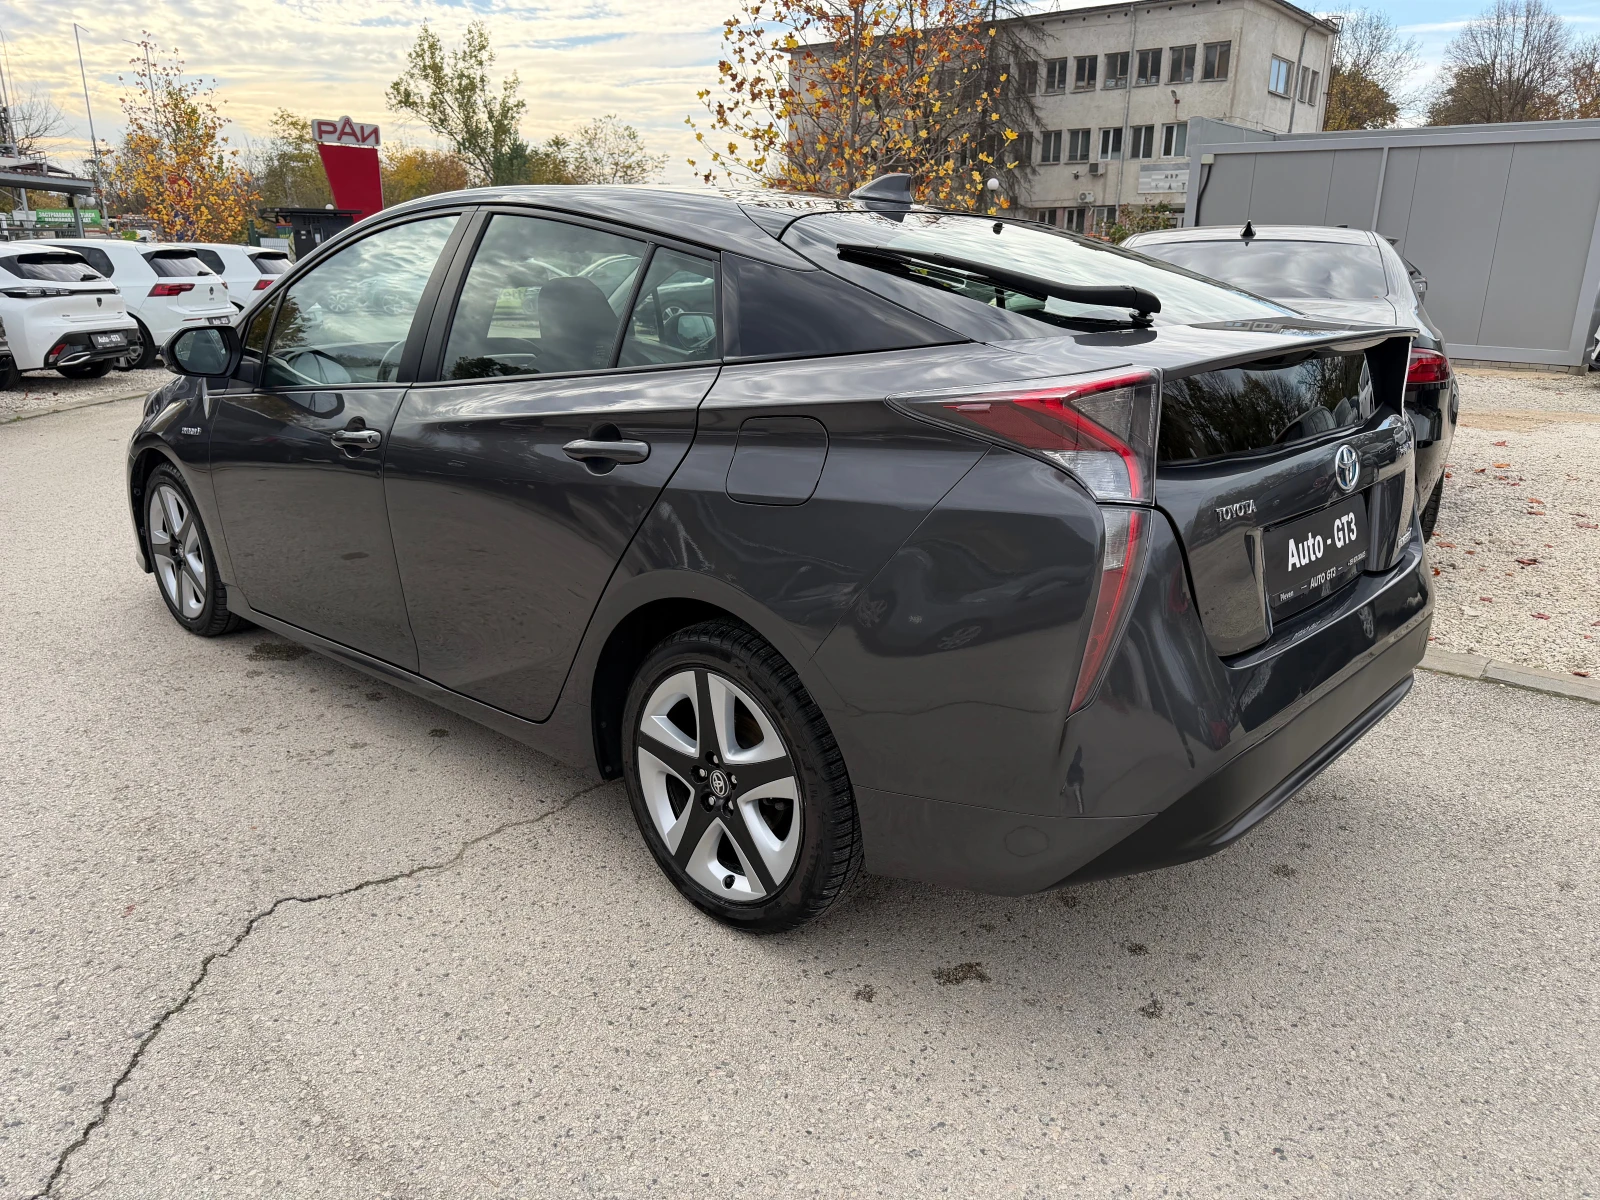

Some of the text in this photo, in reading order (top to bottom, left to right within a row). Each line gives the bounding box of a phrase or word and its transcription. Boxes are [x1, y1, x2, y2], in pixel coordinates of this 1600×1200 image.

[1215, 499, 1257, 522] TOYOTA
[1288, 531, 1324, 572] Auto
[1333, 511, 1357, 549] GT3
[1309, 566, 1337, 590] AUTO GT3
[1280, 590, 1294, 602] Pleven
